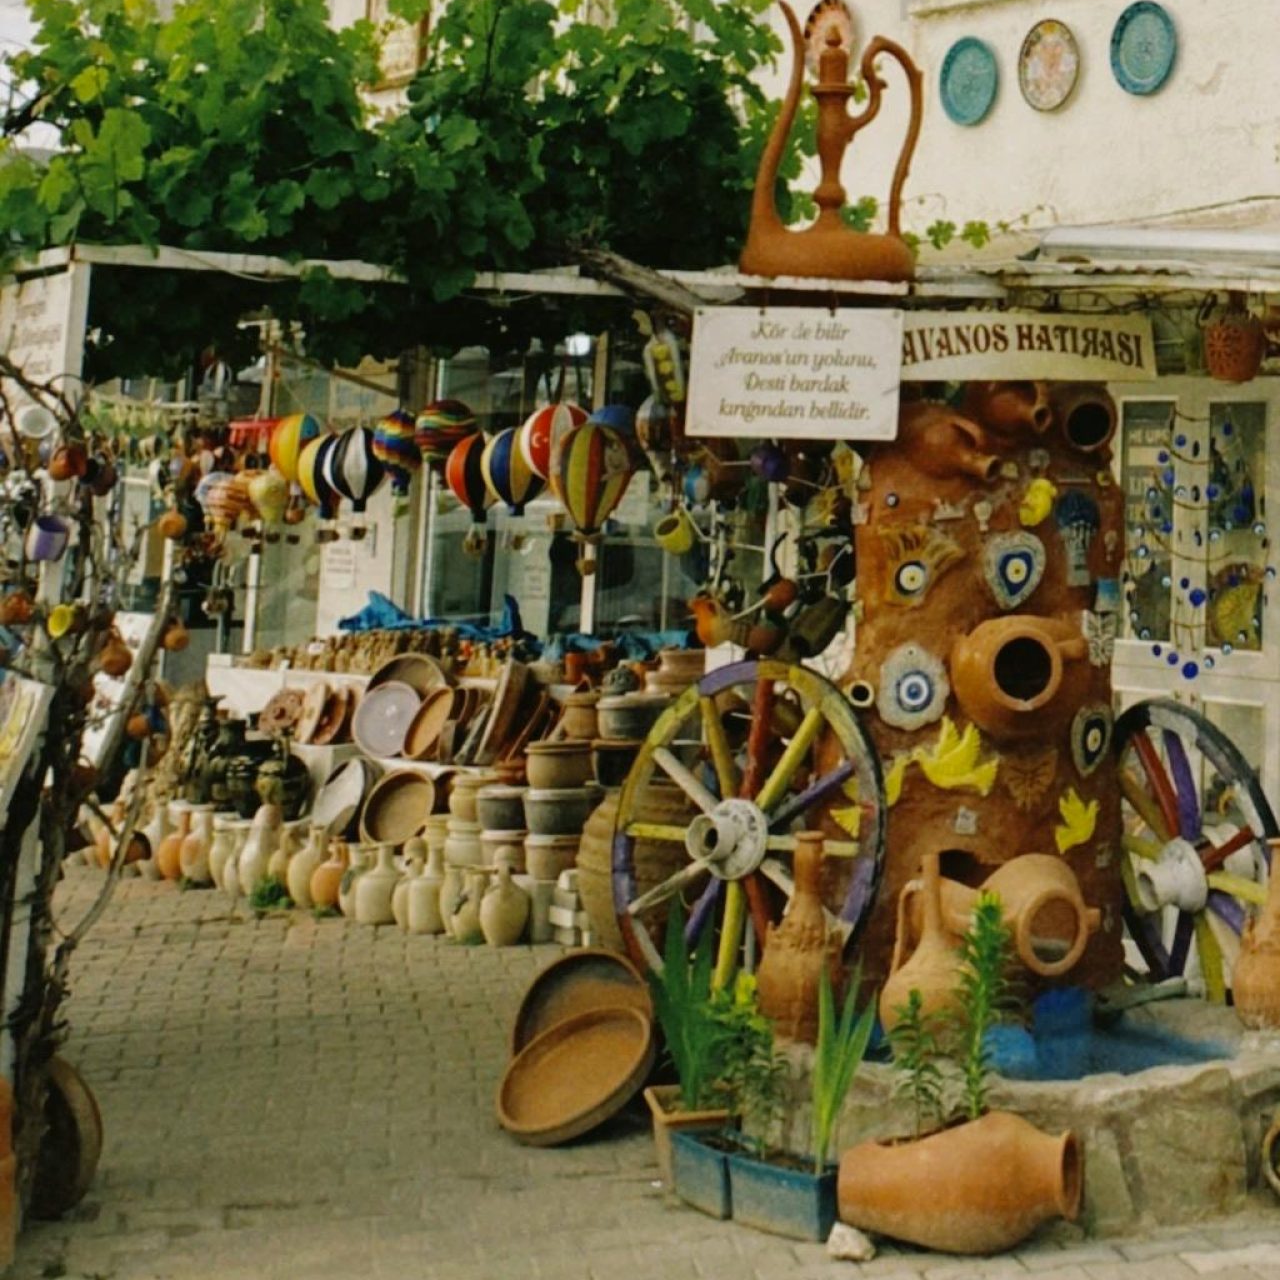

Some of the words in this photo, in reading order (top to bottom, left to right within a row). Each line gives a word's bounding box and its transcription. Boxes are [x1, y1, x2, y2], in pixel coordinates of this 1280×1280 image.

[751, 321, 787, 340] Kör
[792, 322, 809, 340] de
[814, 322, 850, 340] bilir
[901, 323, 1009, 366] AVANOS
[714, 347, 809, 369] Avanos'un
[812, 348, 877, 371] yolunu,
[744, 371, 786, 392] Desti
[789, 373, 850, 393] bardak
[808, 400, 871, 421] bellidir.
